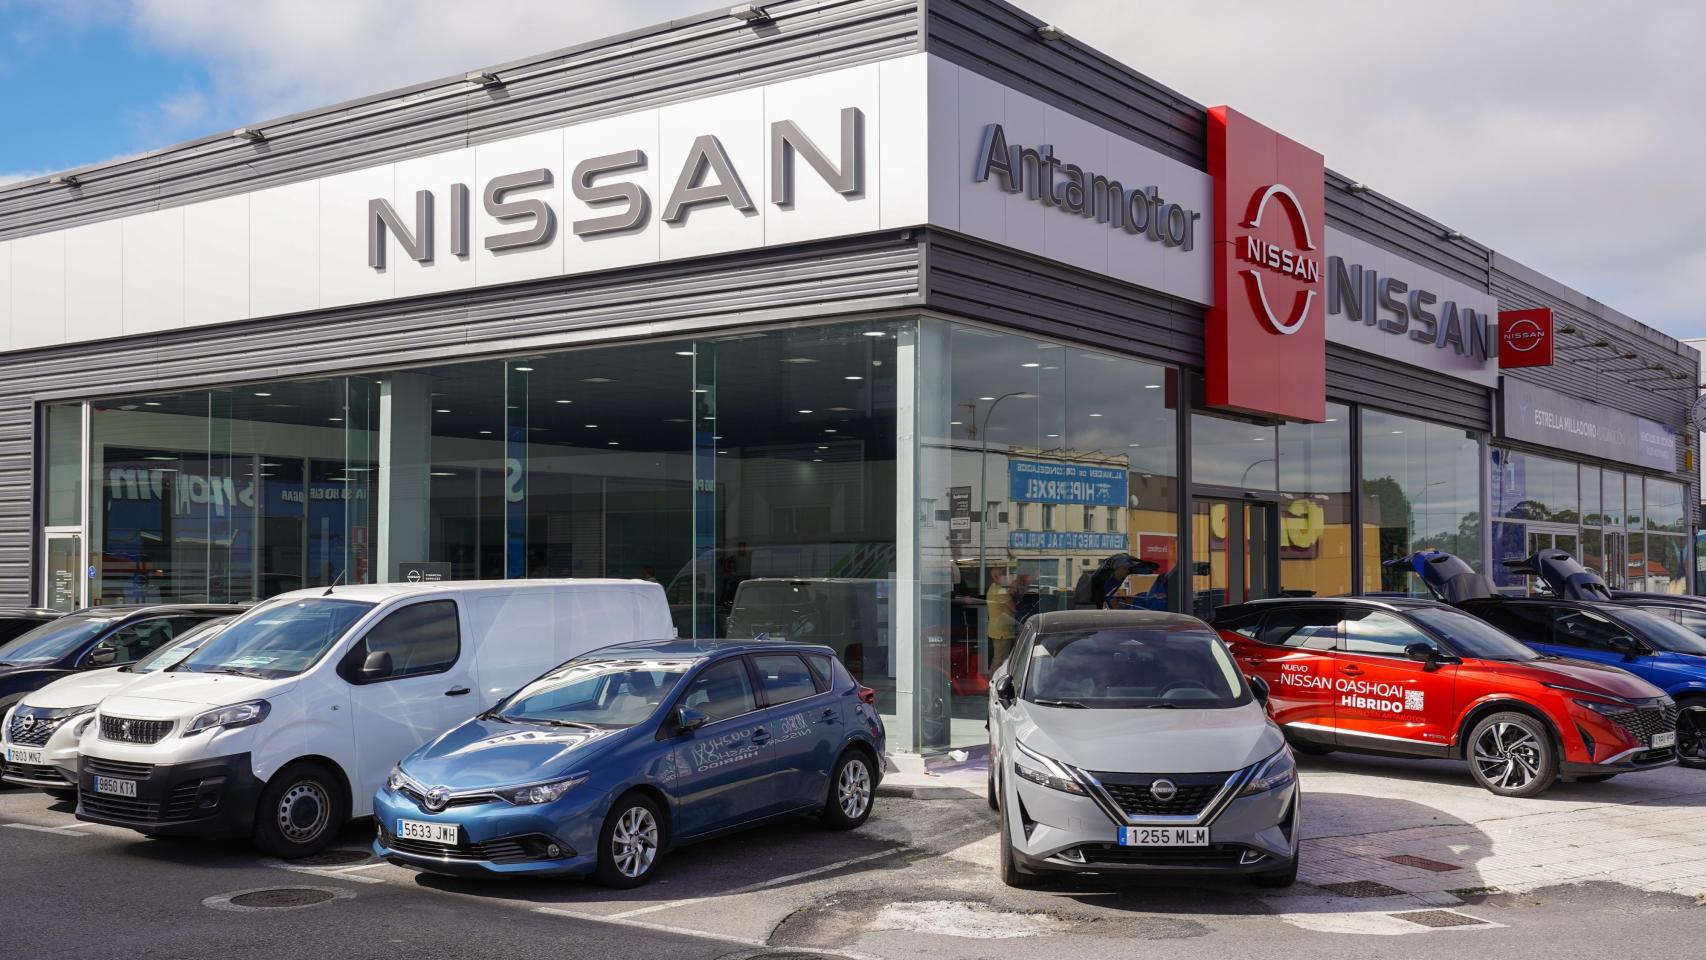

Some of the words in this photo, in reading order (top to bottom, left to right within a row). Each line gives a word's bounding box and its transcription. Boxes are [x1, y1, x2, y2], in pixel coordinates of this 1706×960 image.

[368, 106, 866, 269] NISSAN
[975, 123, 1200, 251] Antamotor
[1246, 235, 1319, 282] NISSAN
[1328, 255, 1488, 361] NISSAN
[1503, 331, 1545, 340] NISSAN
[1534, 409, 1564, 430] ESTRELLA
[1281, 663, 1308, 673] NUEVO
[1280, 673, 1332, 690] NISSAN
[1335, 678, 1403, 698] QASHQAI
[1341, 693, 1403, 713] HÍBRIDO
[98, 778, 118, 794] 9850
[120, 780, 135, 796] KTX
[404, 822, 432, 839] 5633
[436, 826, 455, 842] JWH
[1132, 829, 1170, 844] 1255
[1175, 829, 1206, 844] MLM
